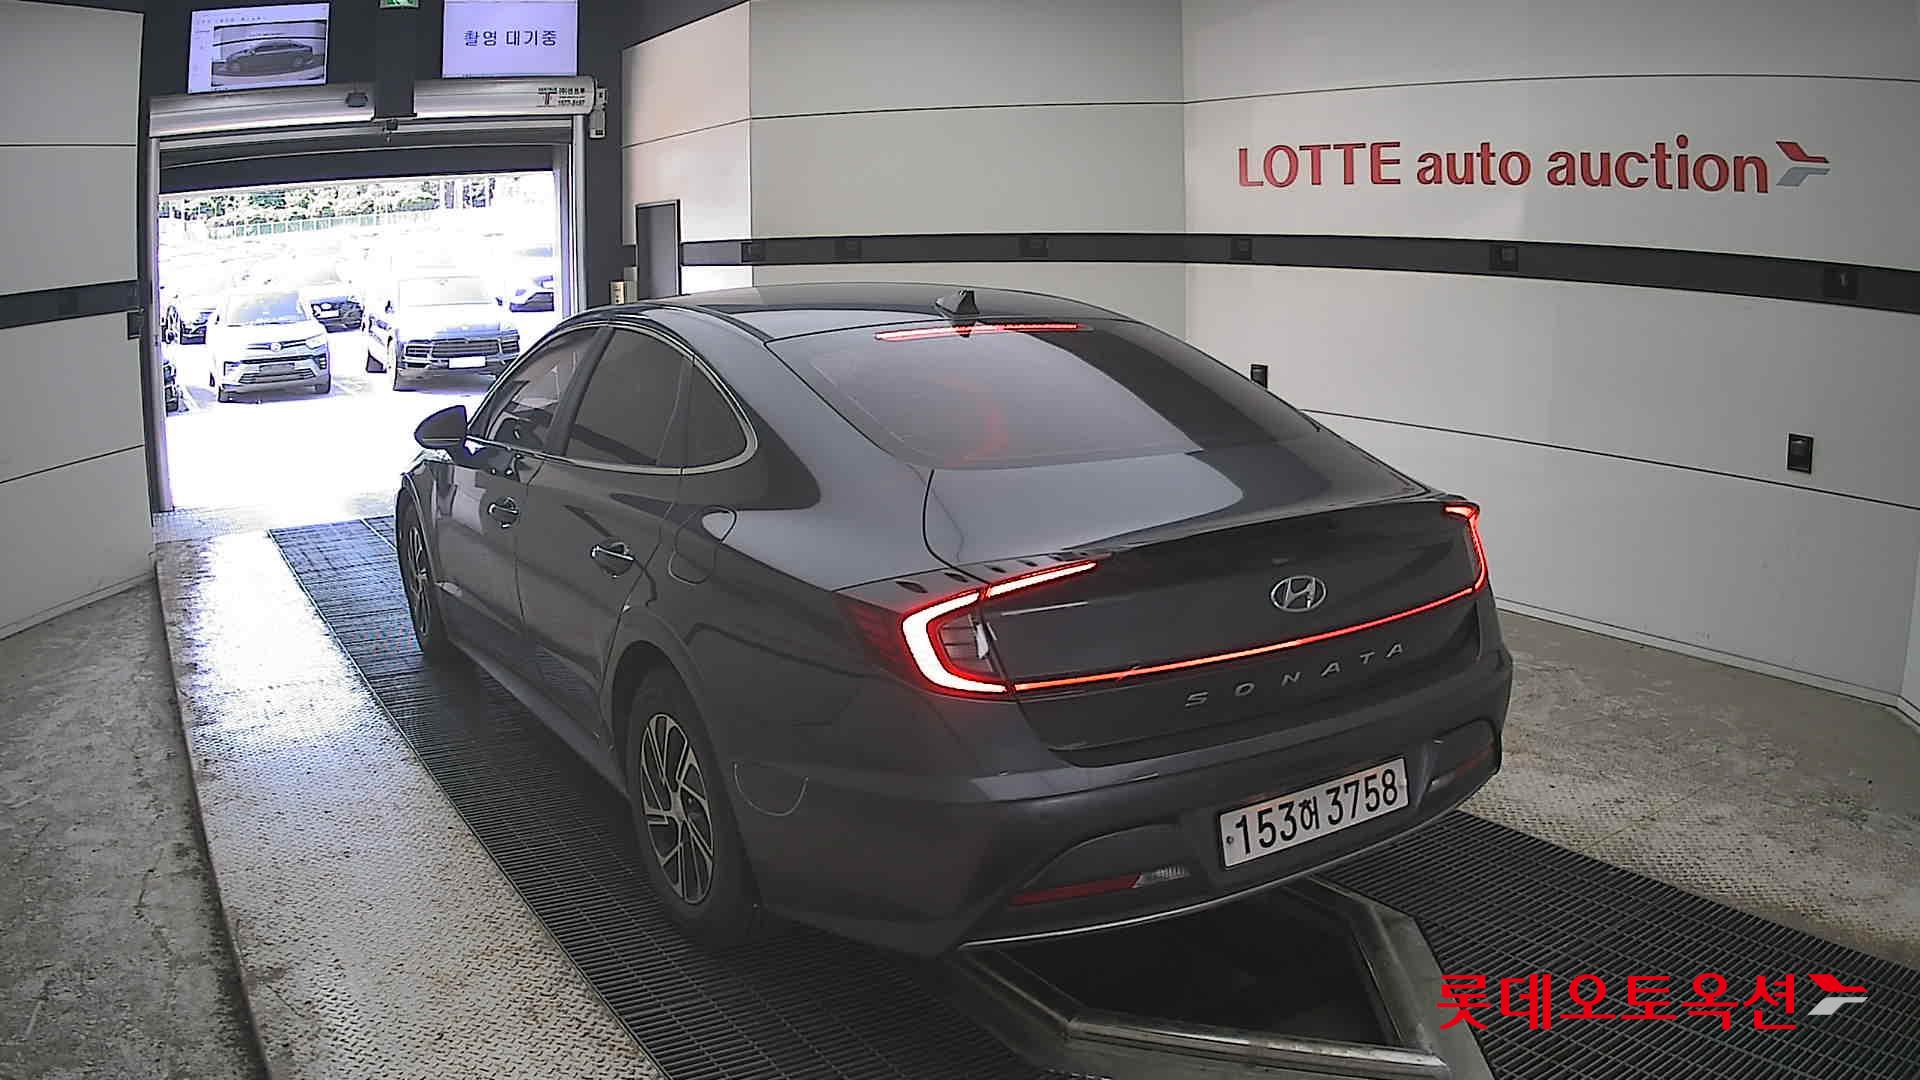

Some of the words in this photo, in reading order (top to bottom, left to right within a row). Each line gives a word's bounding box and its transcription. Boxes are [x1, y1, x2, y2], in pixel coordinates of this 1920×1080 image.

[464, 30, 497, 46] 촬영
[505, 30, 557, 46] 대기중
[1238, 141, 1401, 188] LOTTE
[1416, 142, 1531, 186] auto
[1547, 134, 1768, 193] auction
[1185, 643, 1403, 707] SONATA
[1234, 796, 1320, 855] 153허
[1325, 768, 1398, 825] 3758
